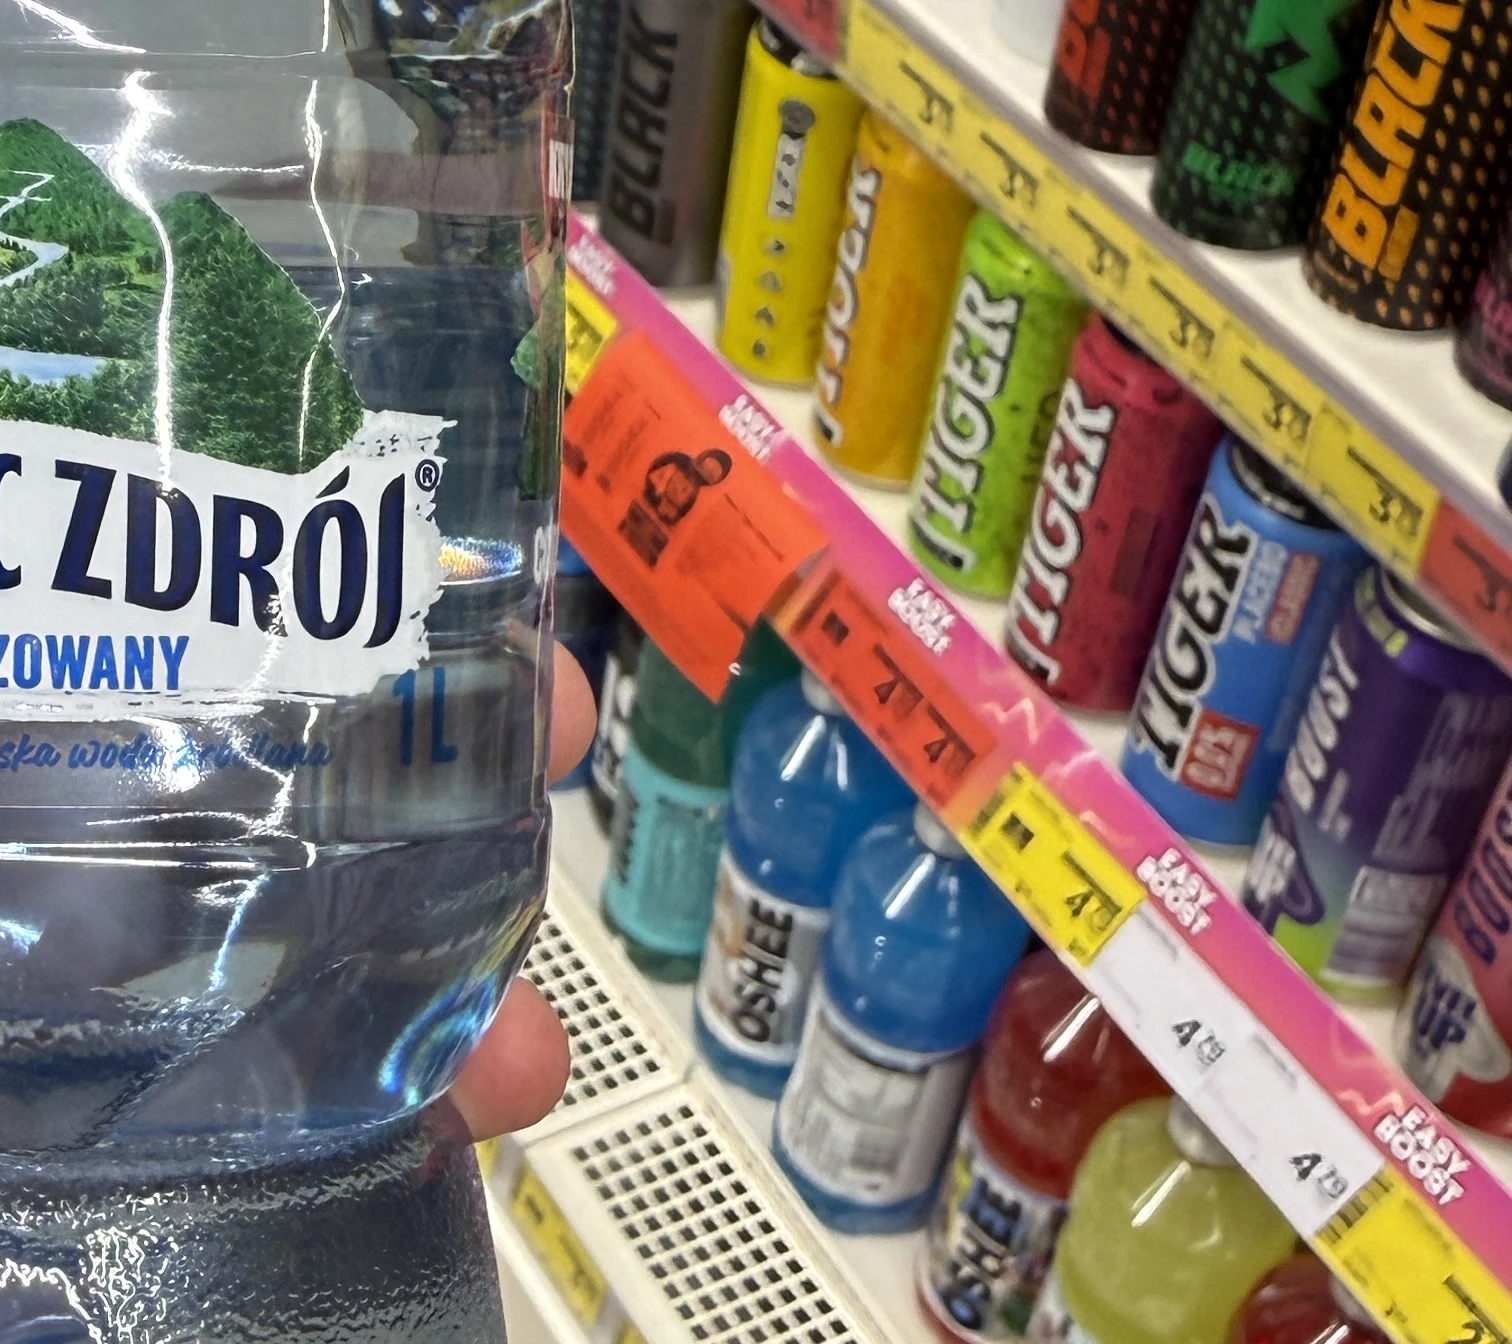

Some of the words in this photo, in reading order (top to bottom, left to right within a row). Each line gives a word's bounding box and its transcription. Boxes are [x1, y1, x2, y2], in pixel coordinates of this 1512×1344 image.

[608, 4, 678, 242] BLACK
[909, 273, 1023, 574] TIGER
[1006, 376, 1116, 685] TIGER
[51, 458, 408, 649] ZDRÓJ
[1138, 496, 1256, 780] TIGER
[732, 899, 793, 1045] OSHEE
[1373, 1112, 1466, 1206] BOOST
[1403, 1104, 1473, 1176] EASY
